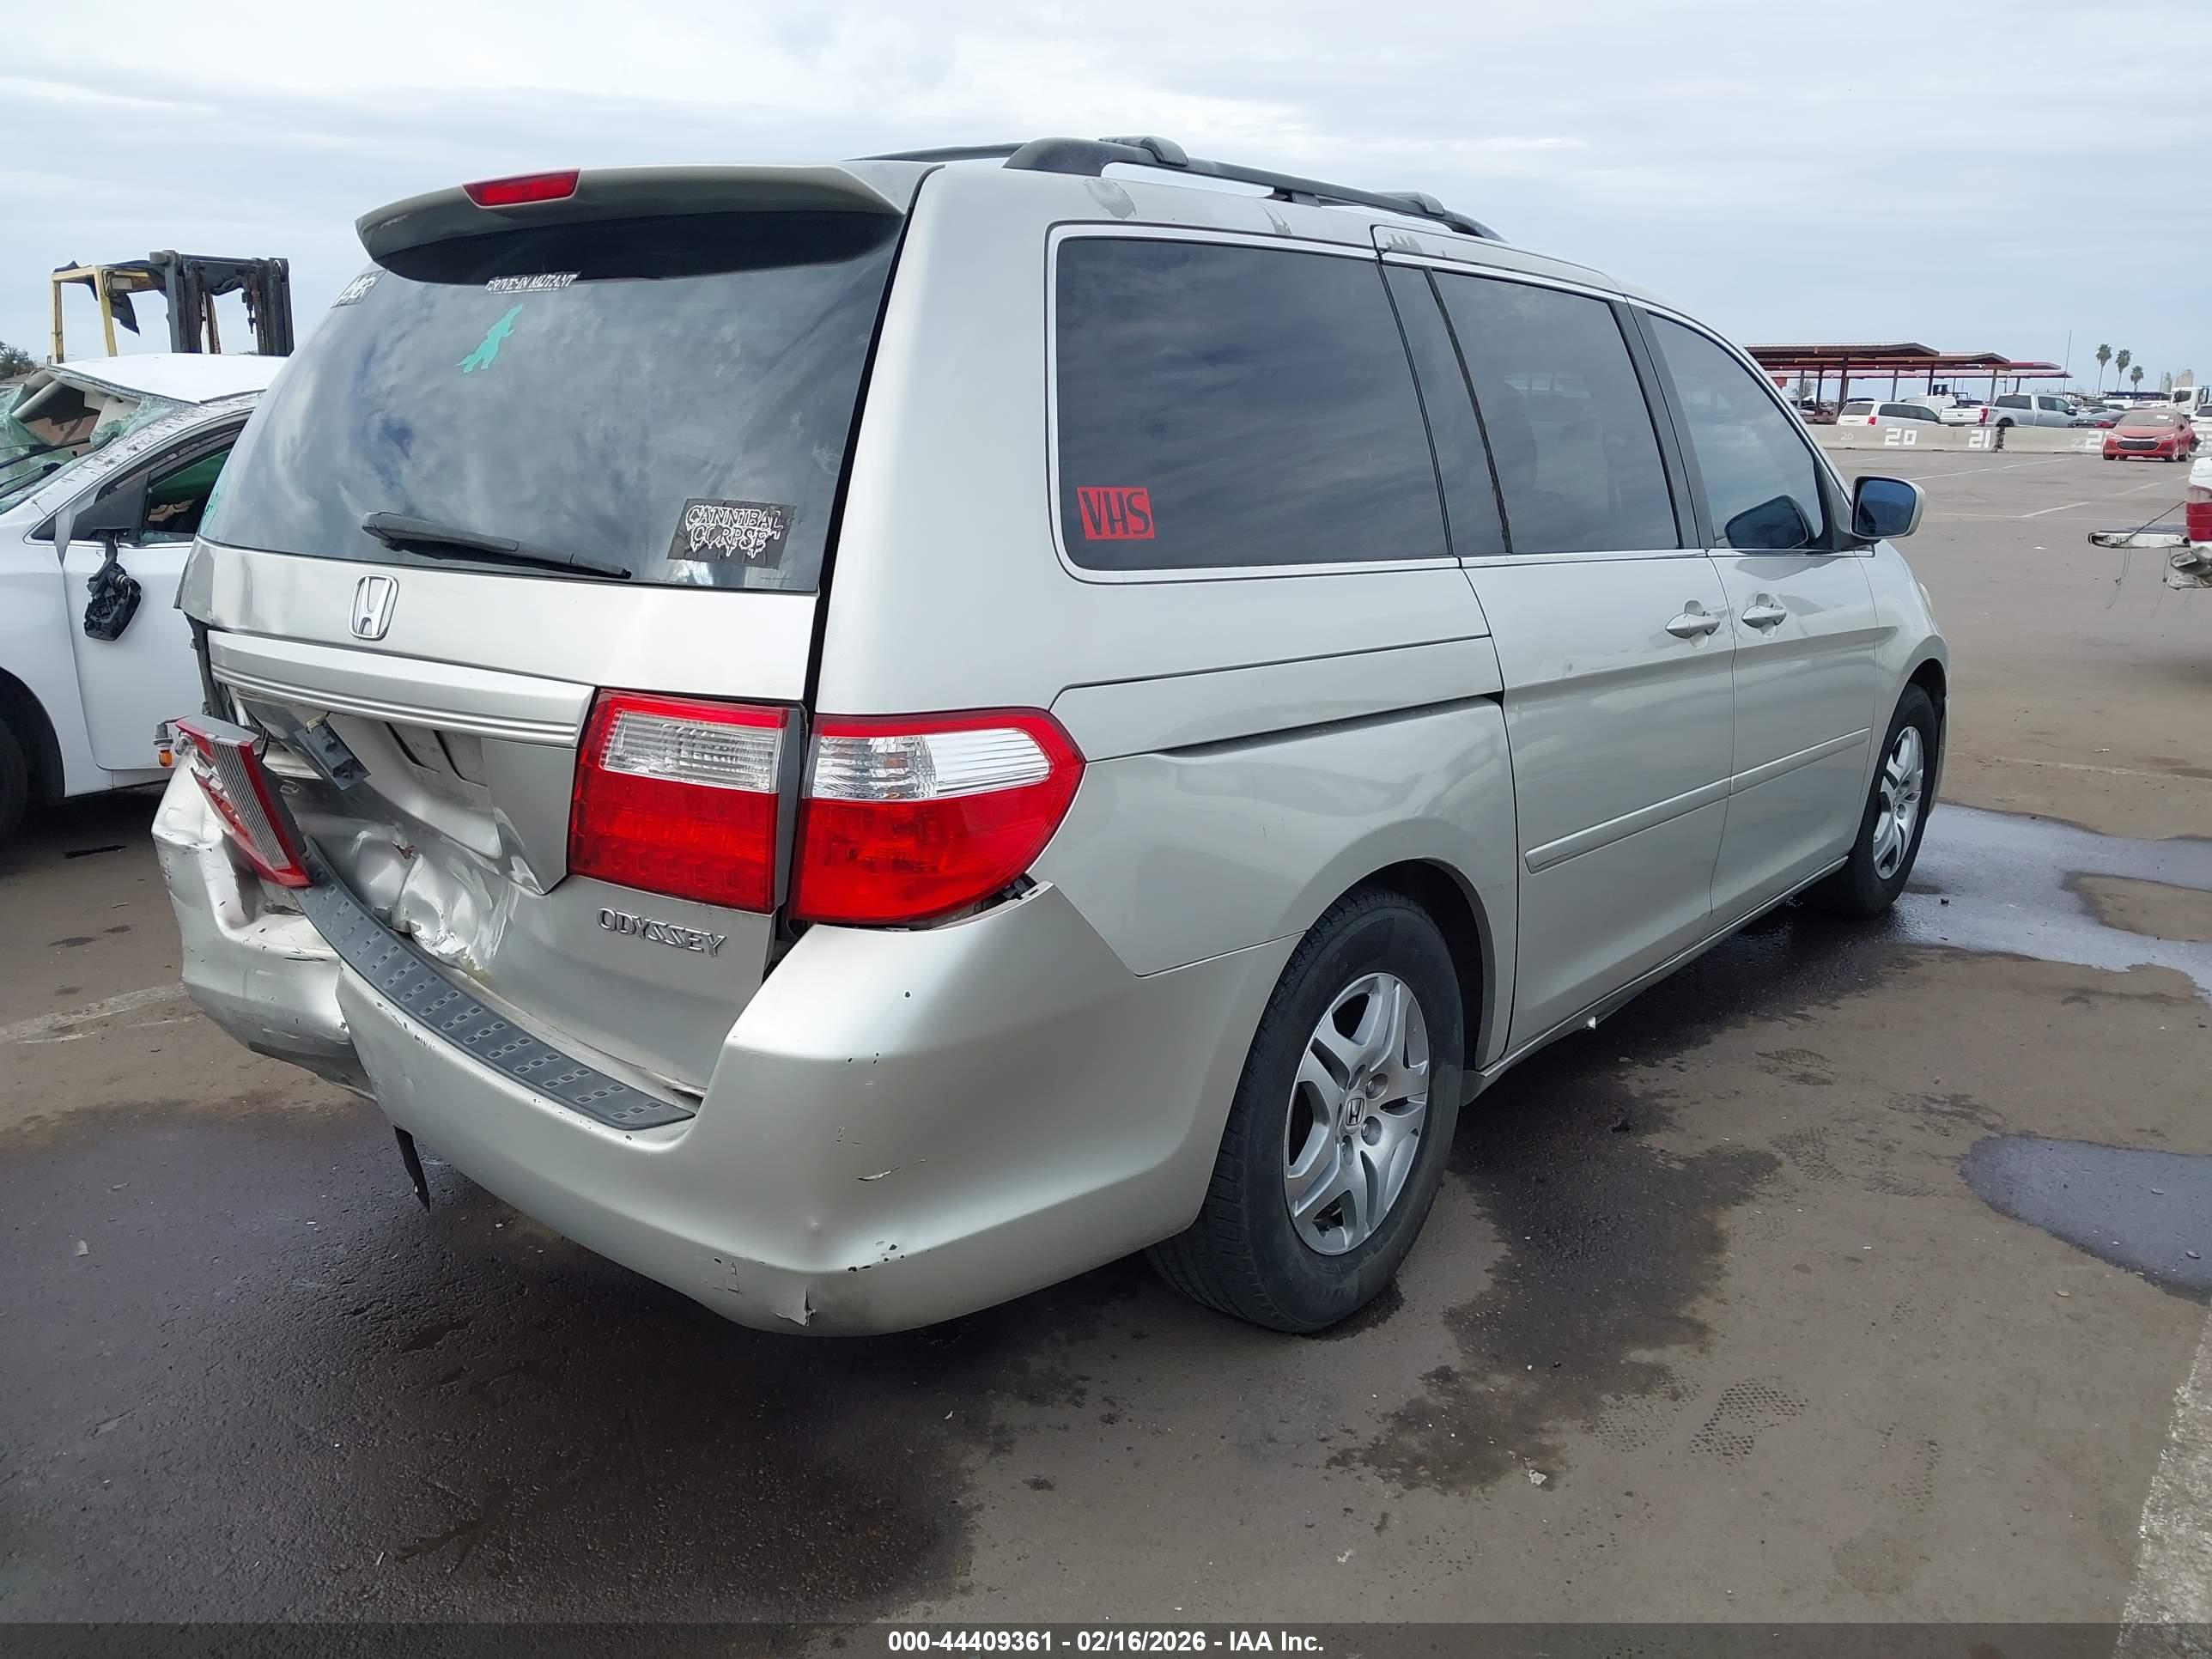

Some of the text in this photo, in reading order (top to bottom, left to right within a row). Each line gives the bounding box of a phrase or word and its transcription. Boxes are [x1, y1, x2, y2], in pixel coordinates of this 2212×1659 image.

[1884, 428, 1917, 447] 20
[1968, 429, 1991, 448] 21
[685, 504, 784, 539] CANNIBAL
[1082, 490, 1151, 536] VHS
[690, 525, 769, 558] CORPSE
[596, 907, 727, 958] ODYSSEY
